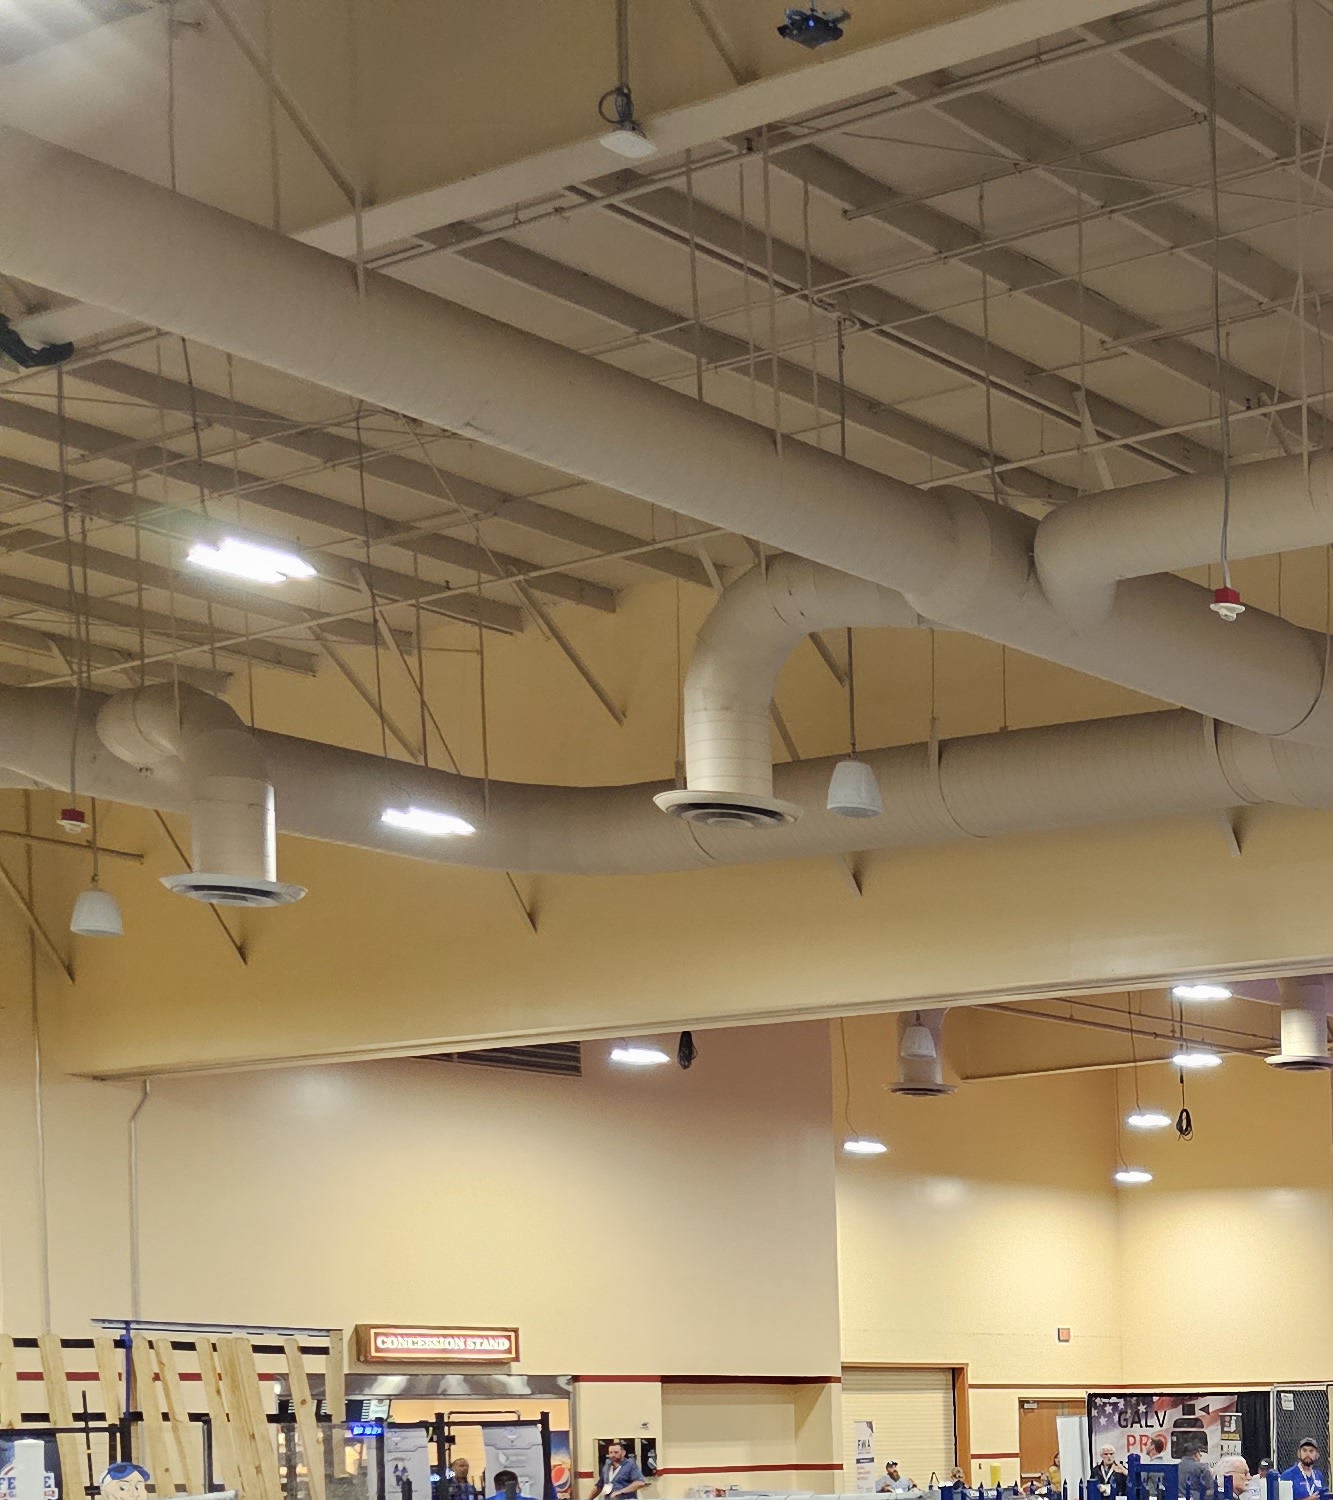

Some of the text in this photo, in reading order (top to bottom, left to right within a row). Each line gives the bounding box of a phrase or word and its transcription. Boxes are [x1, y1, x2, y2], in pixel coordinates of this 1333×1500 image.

[377, 1336, 510, 1351] CONCESSION STAND
[1118, 1410, 1167, 1428] GALV
